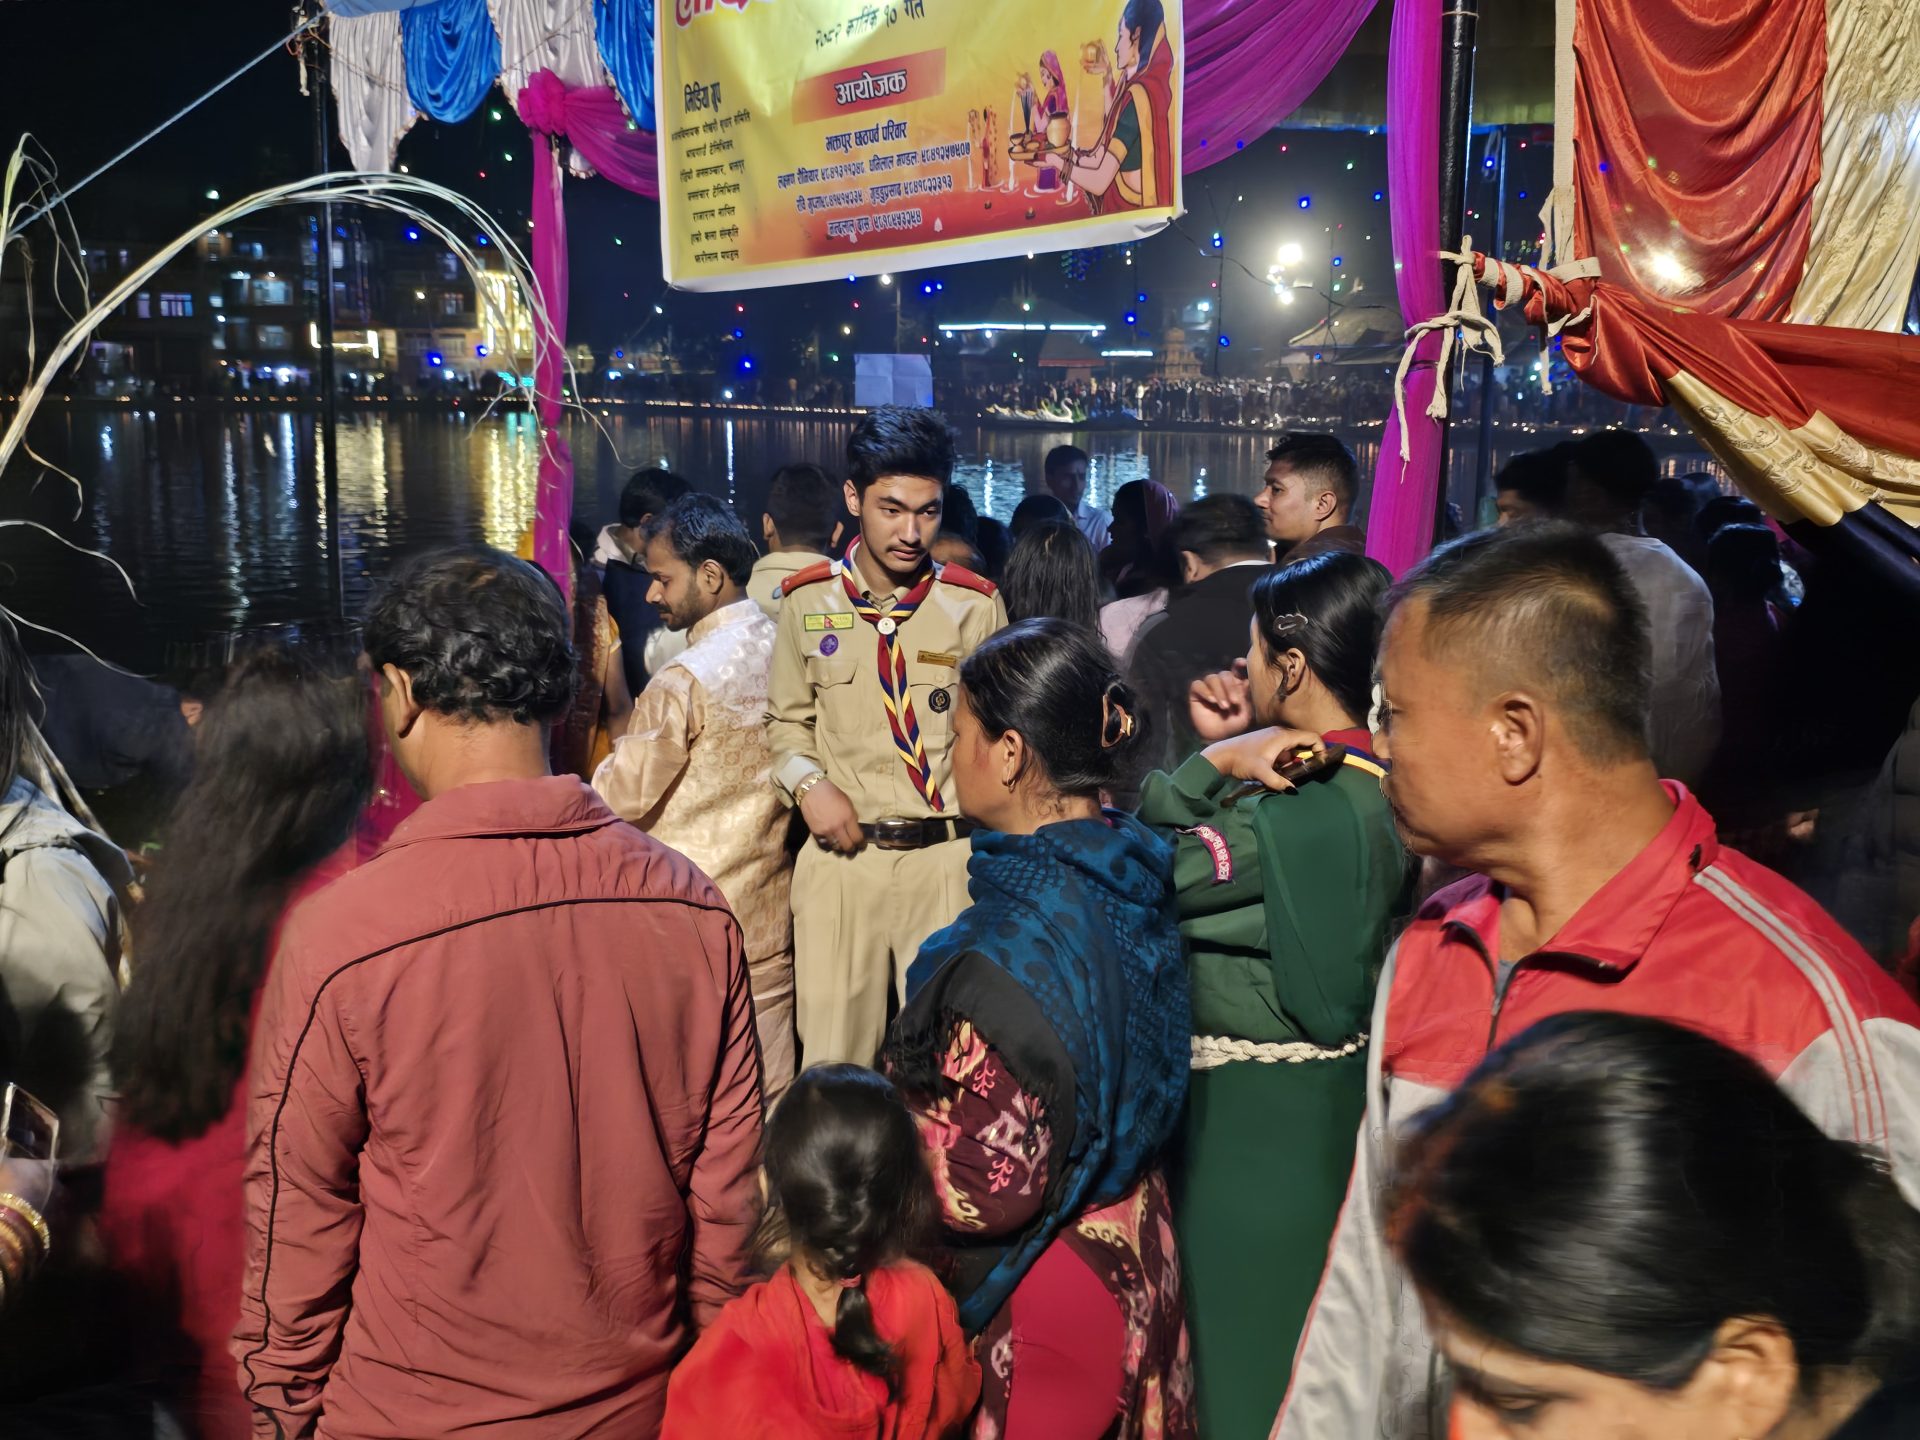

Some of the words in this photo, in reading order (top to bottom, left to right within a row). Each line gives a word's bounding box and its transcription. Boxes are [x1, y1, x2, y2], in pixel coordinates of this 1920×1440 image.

[884, 4, 897, 28] १०
[834, 69, 907, 105] आयोजक
[825, 132, 852, 154] भक्तपुर
[881, 119, 907, 141] परिवार
